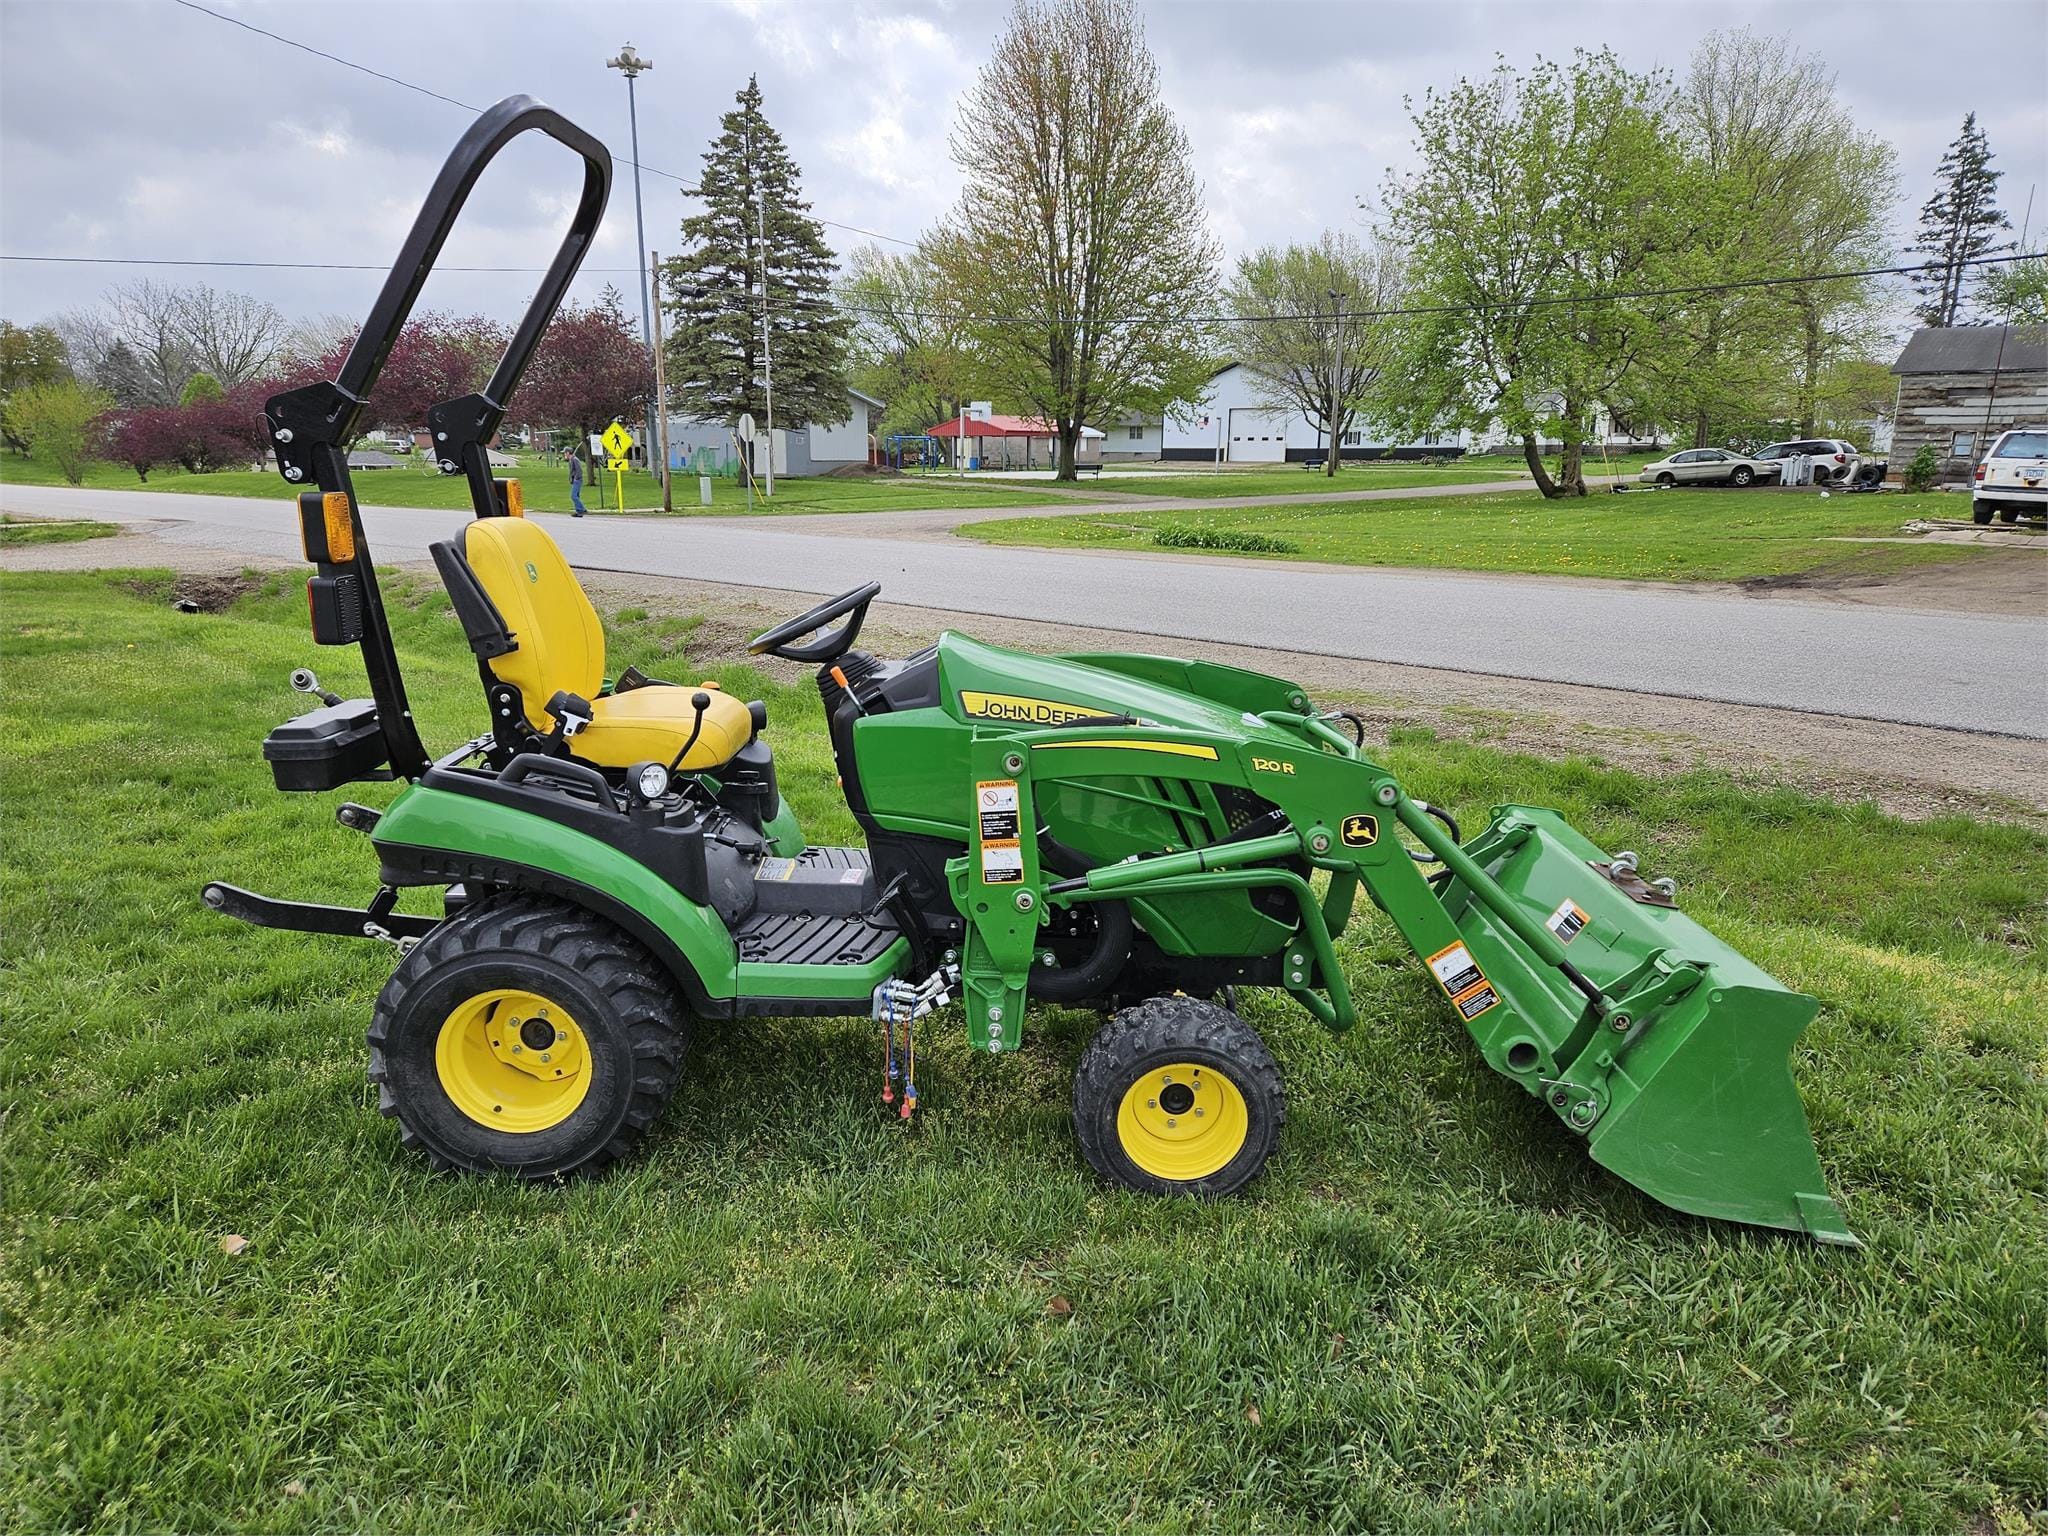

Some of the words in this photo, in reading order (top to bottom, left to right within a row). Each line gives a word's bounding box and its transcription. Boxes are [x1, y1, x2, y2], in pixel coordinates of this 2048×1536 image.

[978, 699, 1031, 719] JOHN
[1251, 757, 1280, 772] 120
[1281, 761, 1296, 775] R
[989, 841, 1019, 849] WARNING
